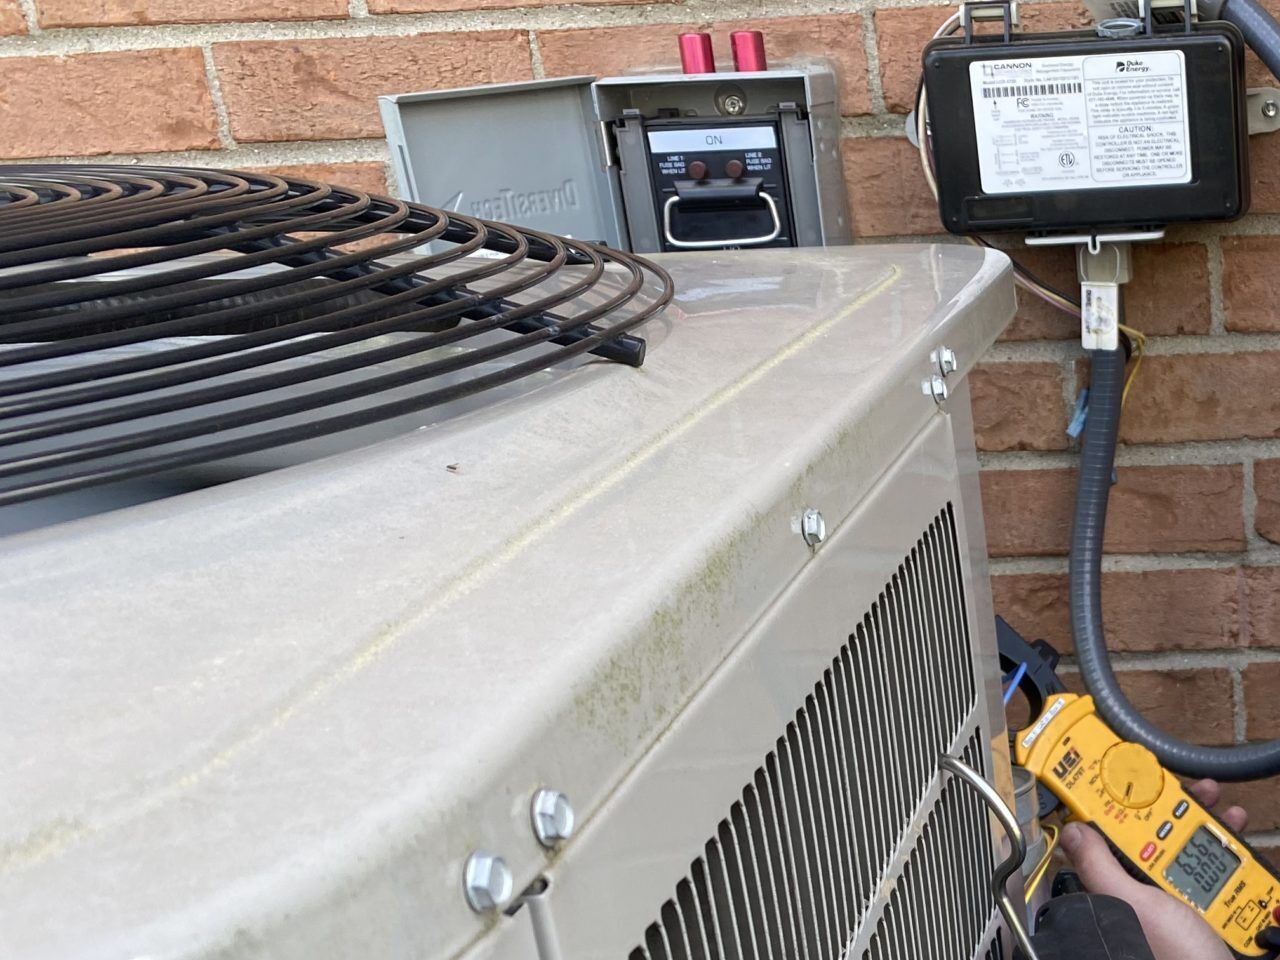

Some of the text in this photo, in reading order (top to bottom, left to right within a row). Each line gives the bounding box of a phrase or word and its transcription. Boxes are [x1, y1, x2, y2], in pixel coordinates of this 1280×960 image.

[993, 62, 1032, 70] CANNON
[705, 135, 723, 145] ON
[1224, 894, 1236, 908] True
[1233, 880, 1246, 896] RMS
